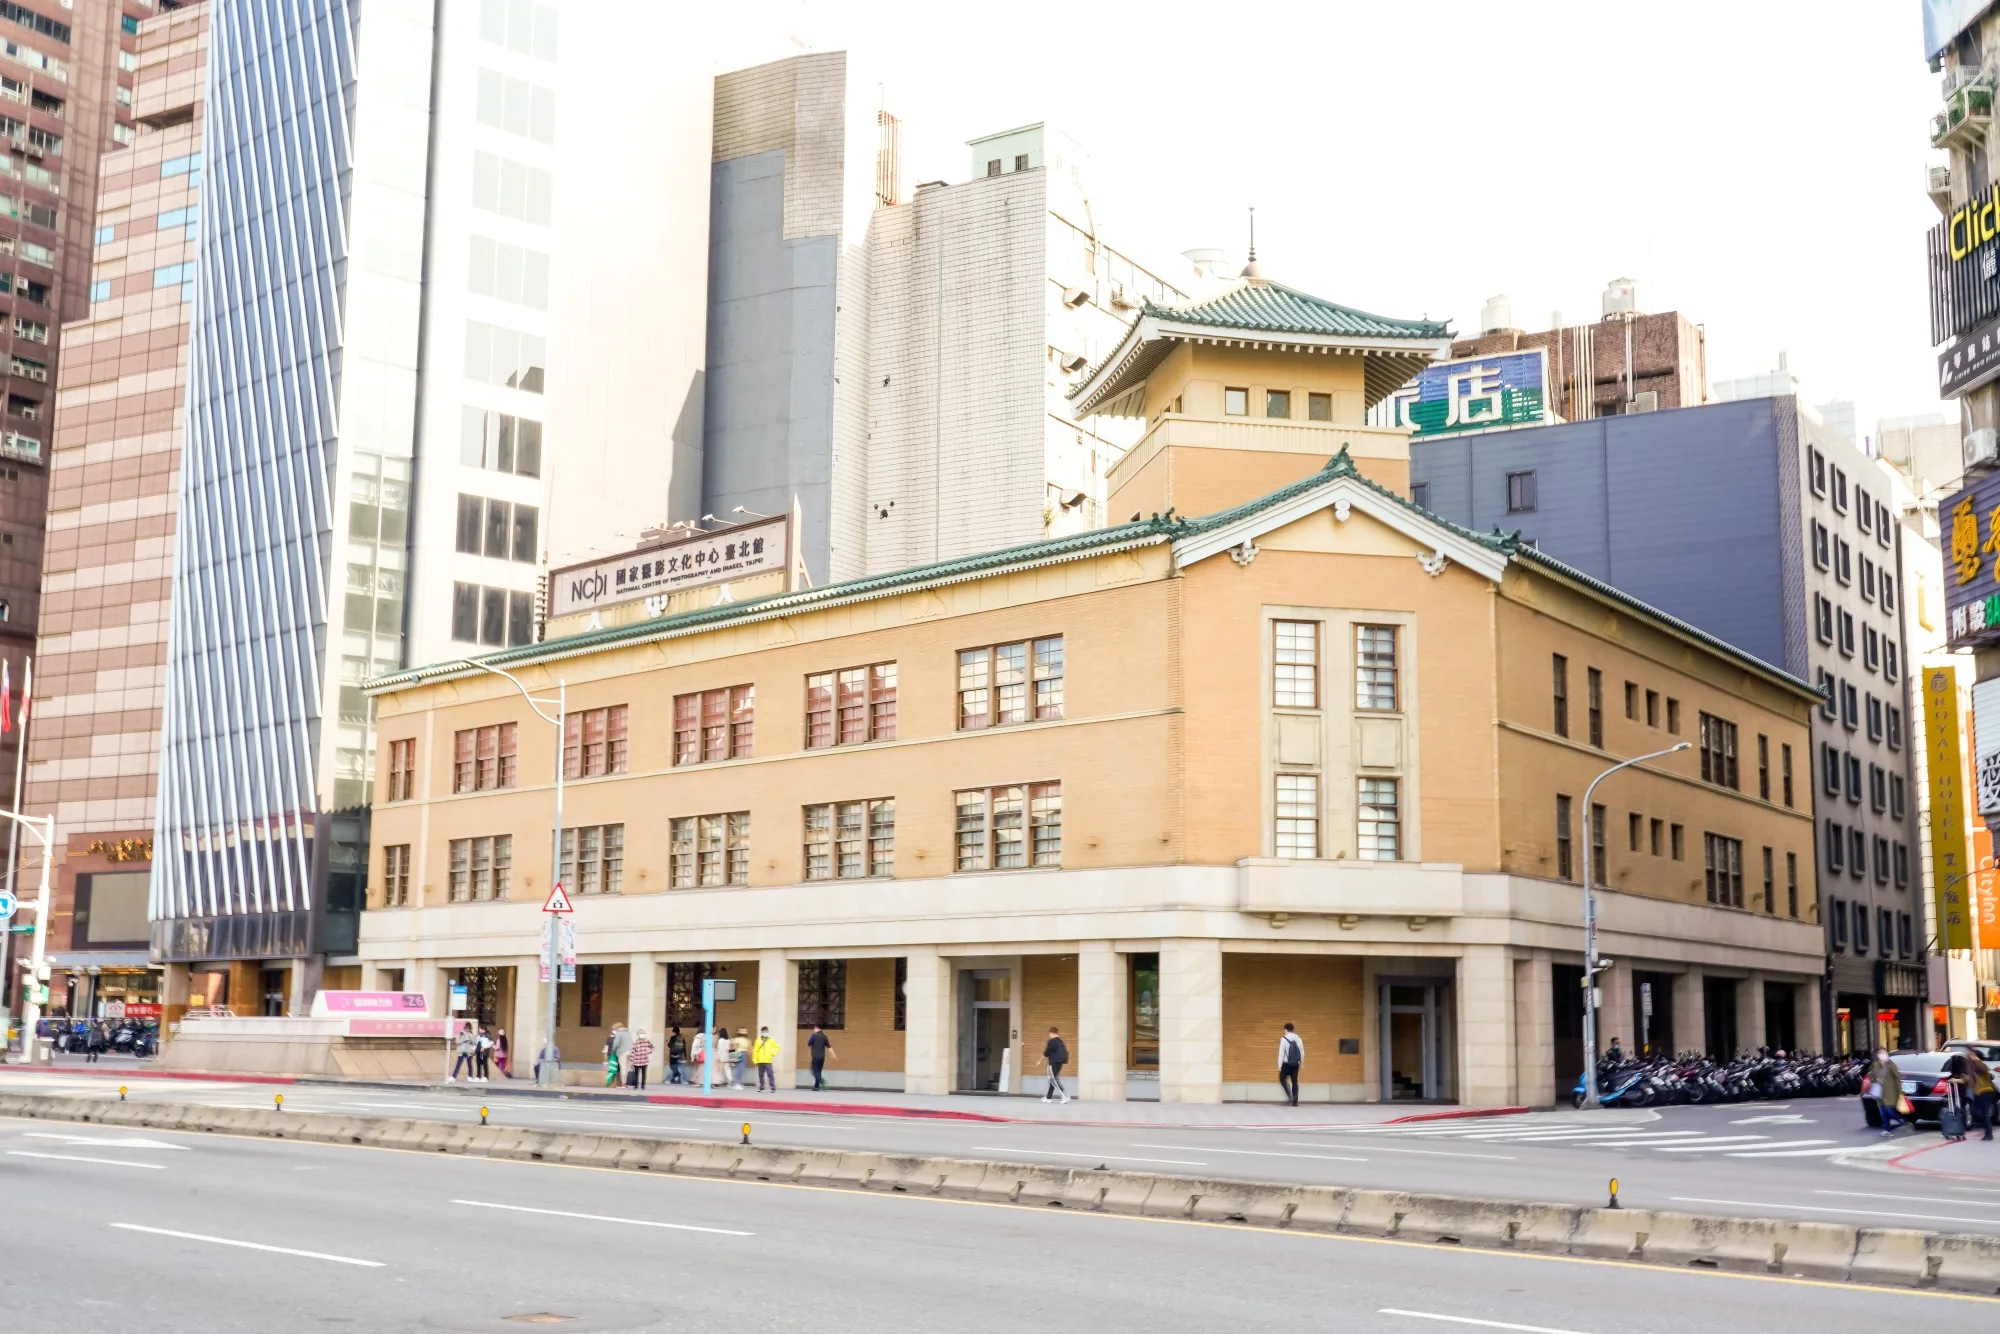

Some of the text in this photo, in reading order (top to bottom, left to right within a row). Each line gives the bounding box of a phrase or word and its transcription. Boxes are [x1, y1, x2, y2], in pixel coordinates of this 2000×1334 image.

[616, 584, 641, 595] NATIONAL
[642, 579, 662, 589] CENTER
[670, 569, 708, 583] PHOTOGRAPHY
[710, 567, 722, 575] AND
[746, 557, 764, 567] TAIPEI
[1934, 697, 1950, 762] ROYAL
[1939, 775, 1955, 840] HOTEL
